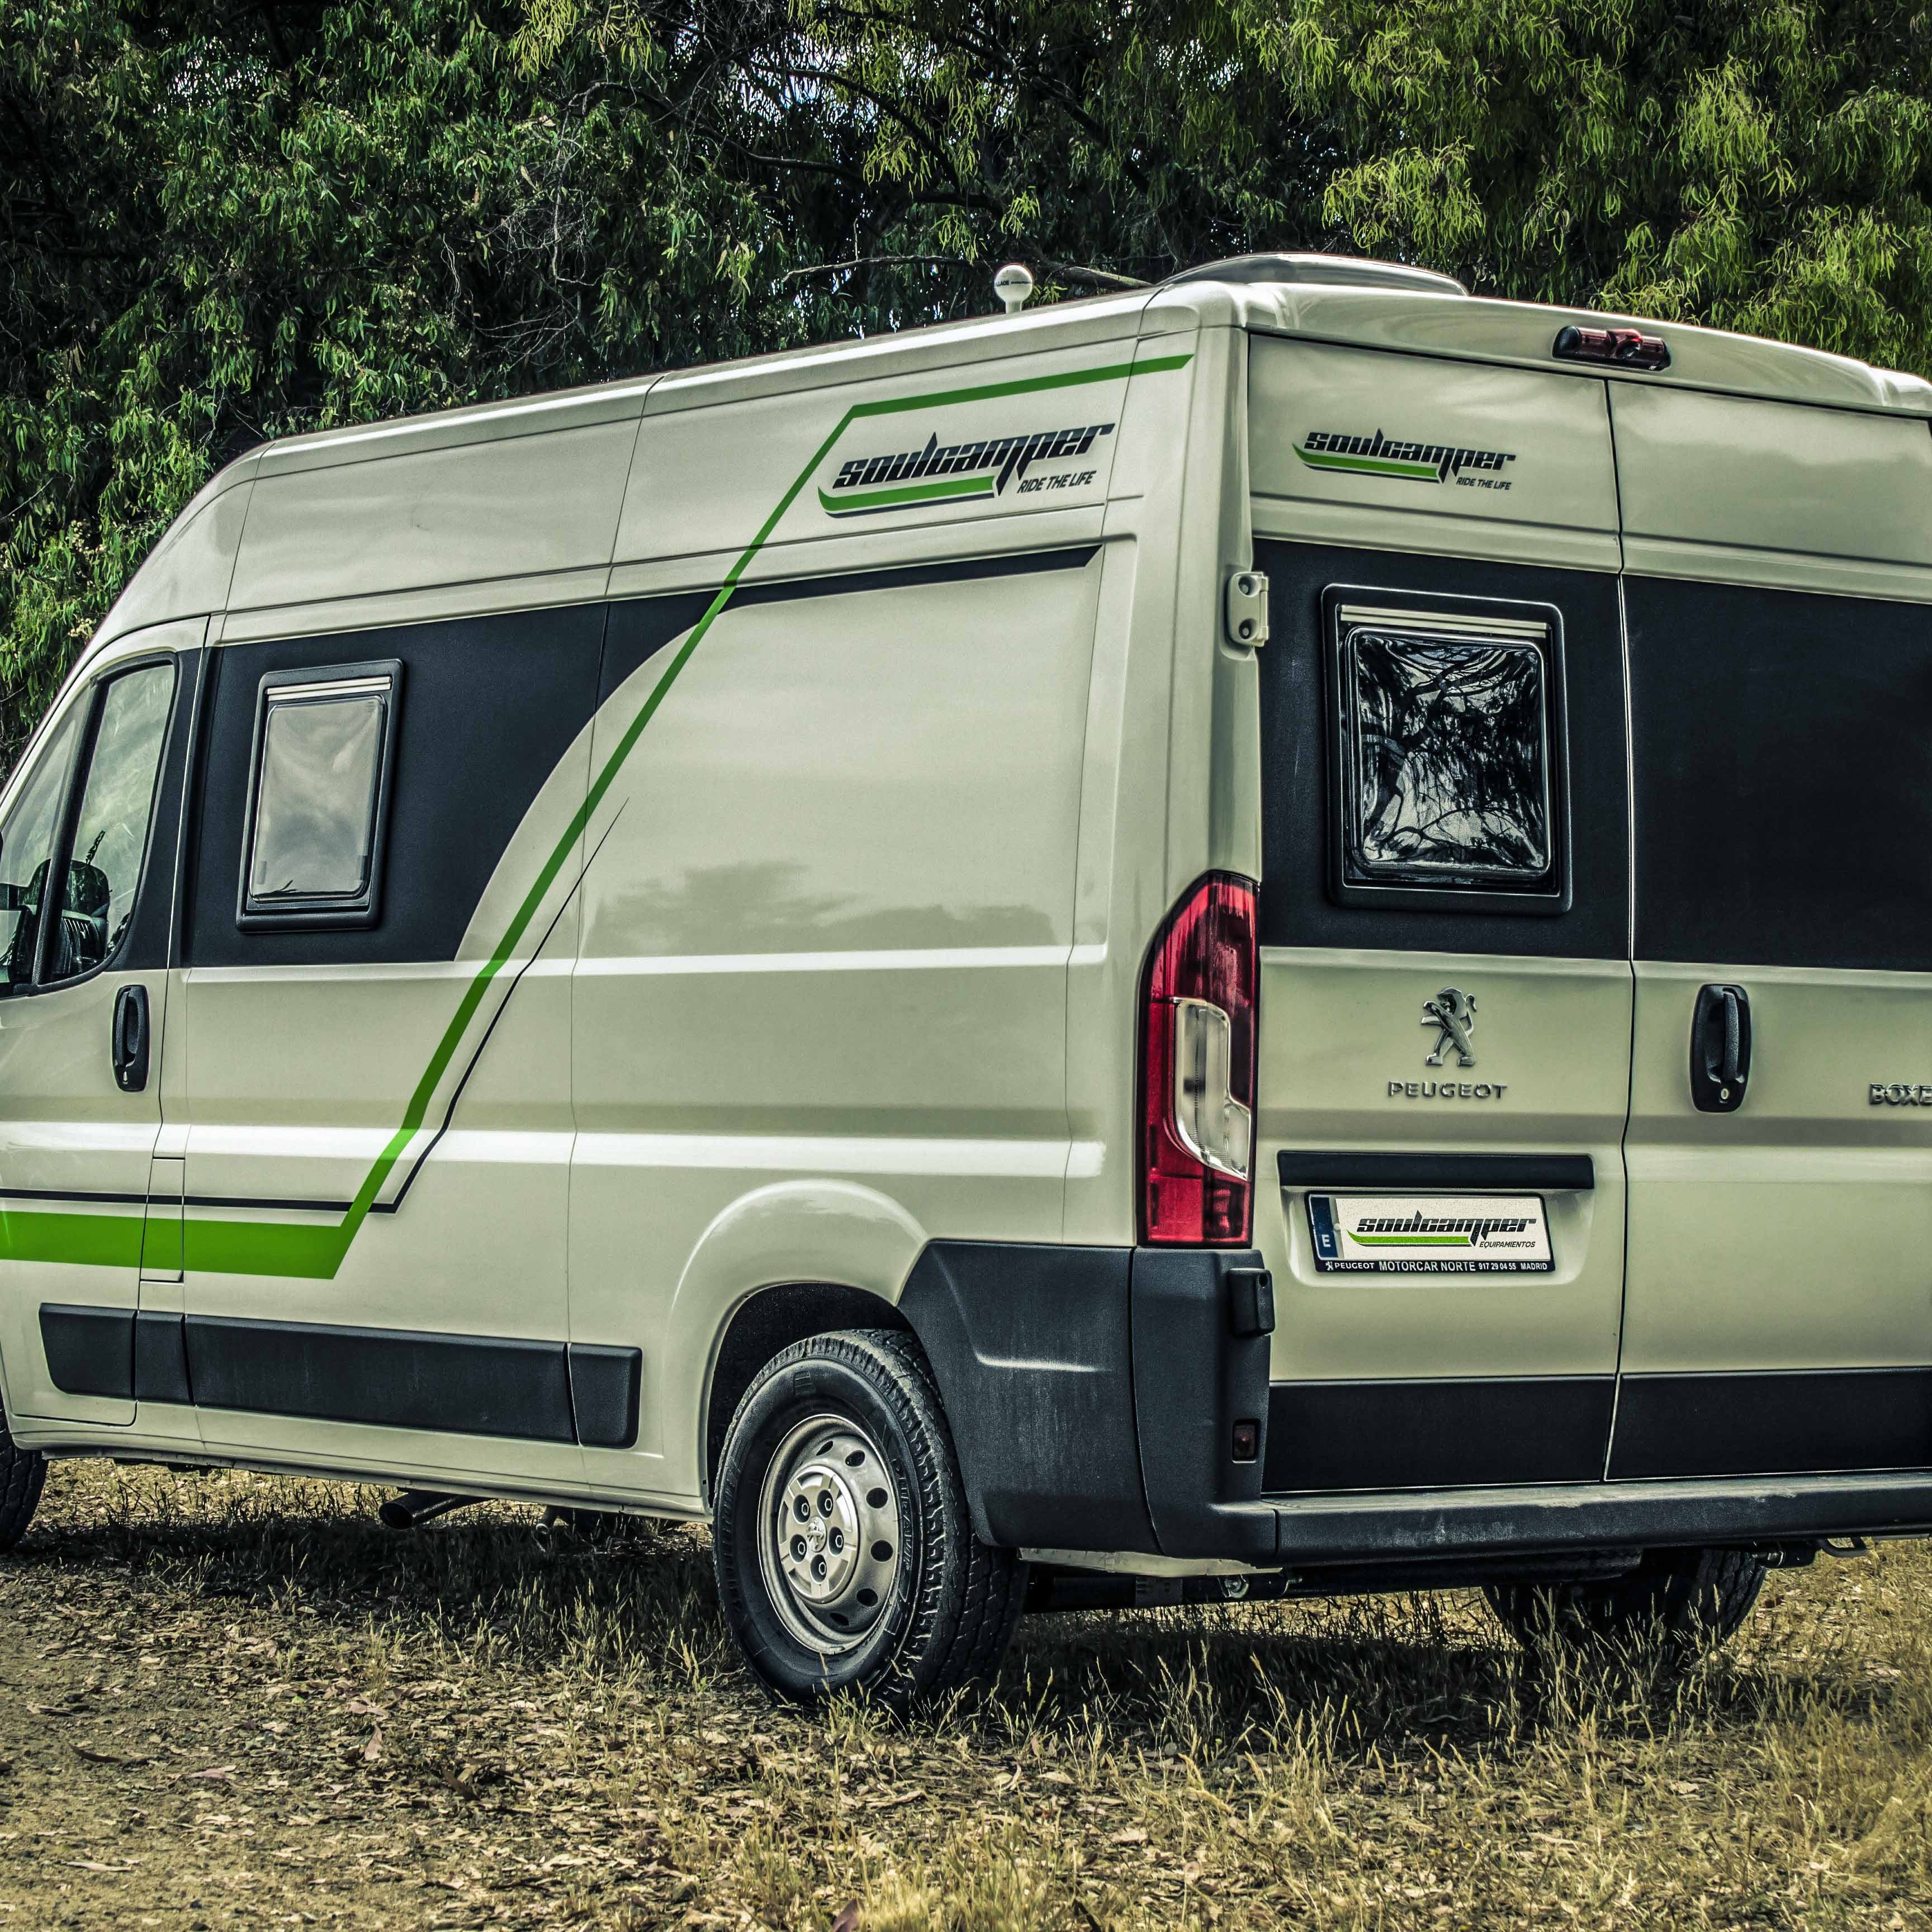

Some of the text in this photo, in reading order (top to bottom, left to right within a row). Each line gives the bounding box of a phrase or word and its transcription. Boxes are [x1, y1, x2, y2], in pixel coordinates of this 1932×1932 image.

[832, 423, 1116, 496] soulcamper
[1304, 428, 1516, 484] soulcamper
[1017, 470, 1097, 493] RIDE THE LIFE
[1456, 477, 1512, 490] RIDE THE LIFE
[1389, 1081, 1508, 1099] PEUGEOT
[1869, 1083, 1932, 1106] BOXE
[1357, 1210, 1537, 1247] soulcamper
[1322, 1234, 1331, 1247] E
[1379, 1261, 1438, 1271] MOTORCAR
[1441, 1261, 1476, 1271] NORTE
